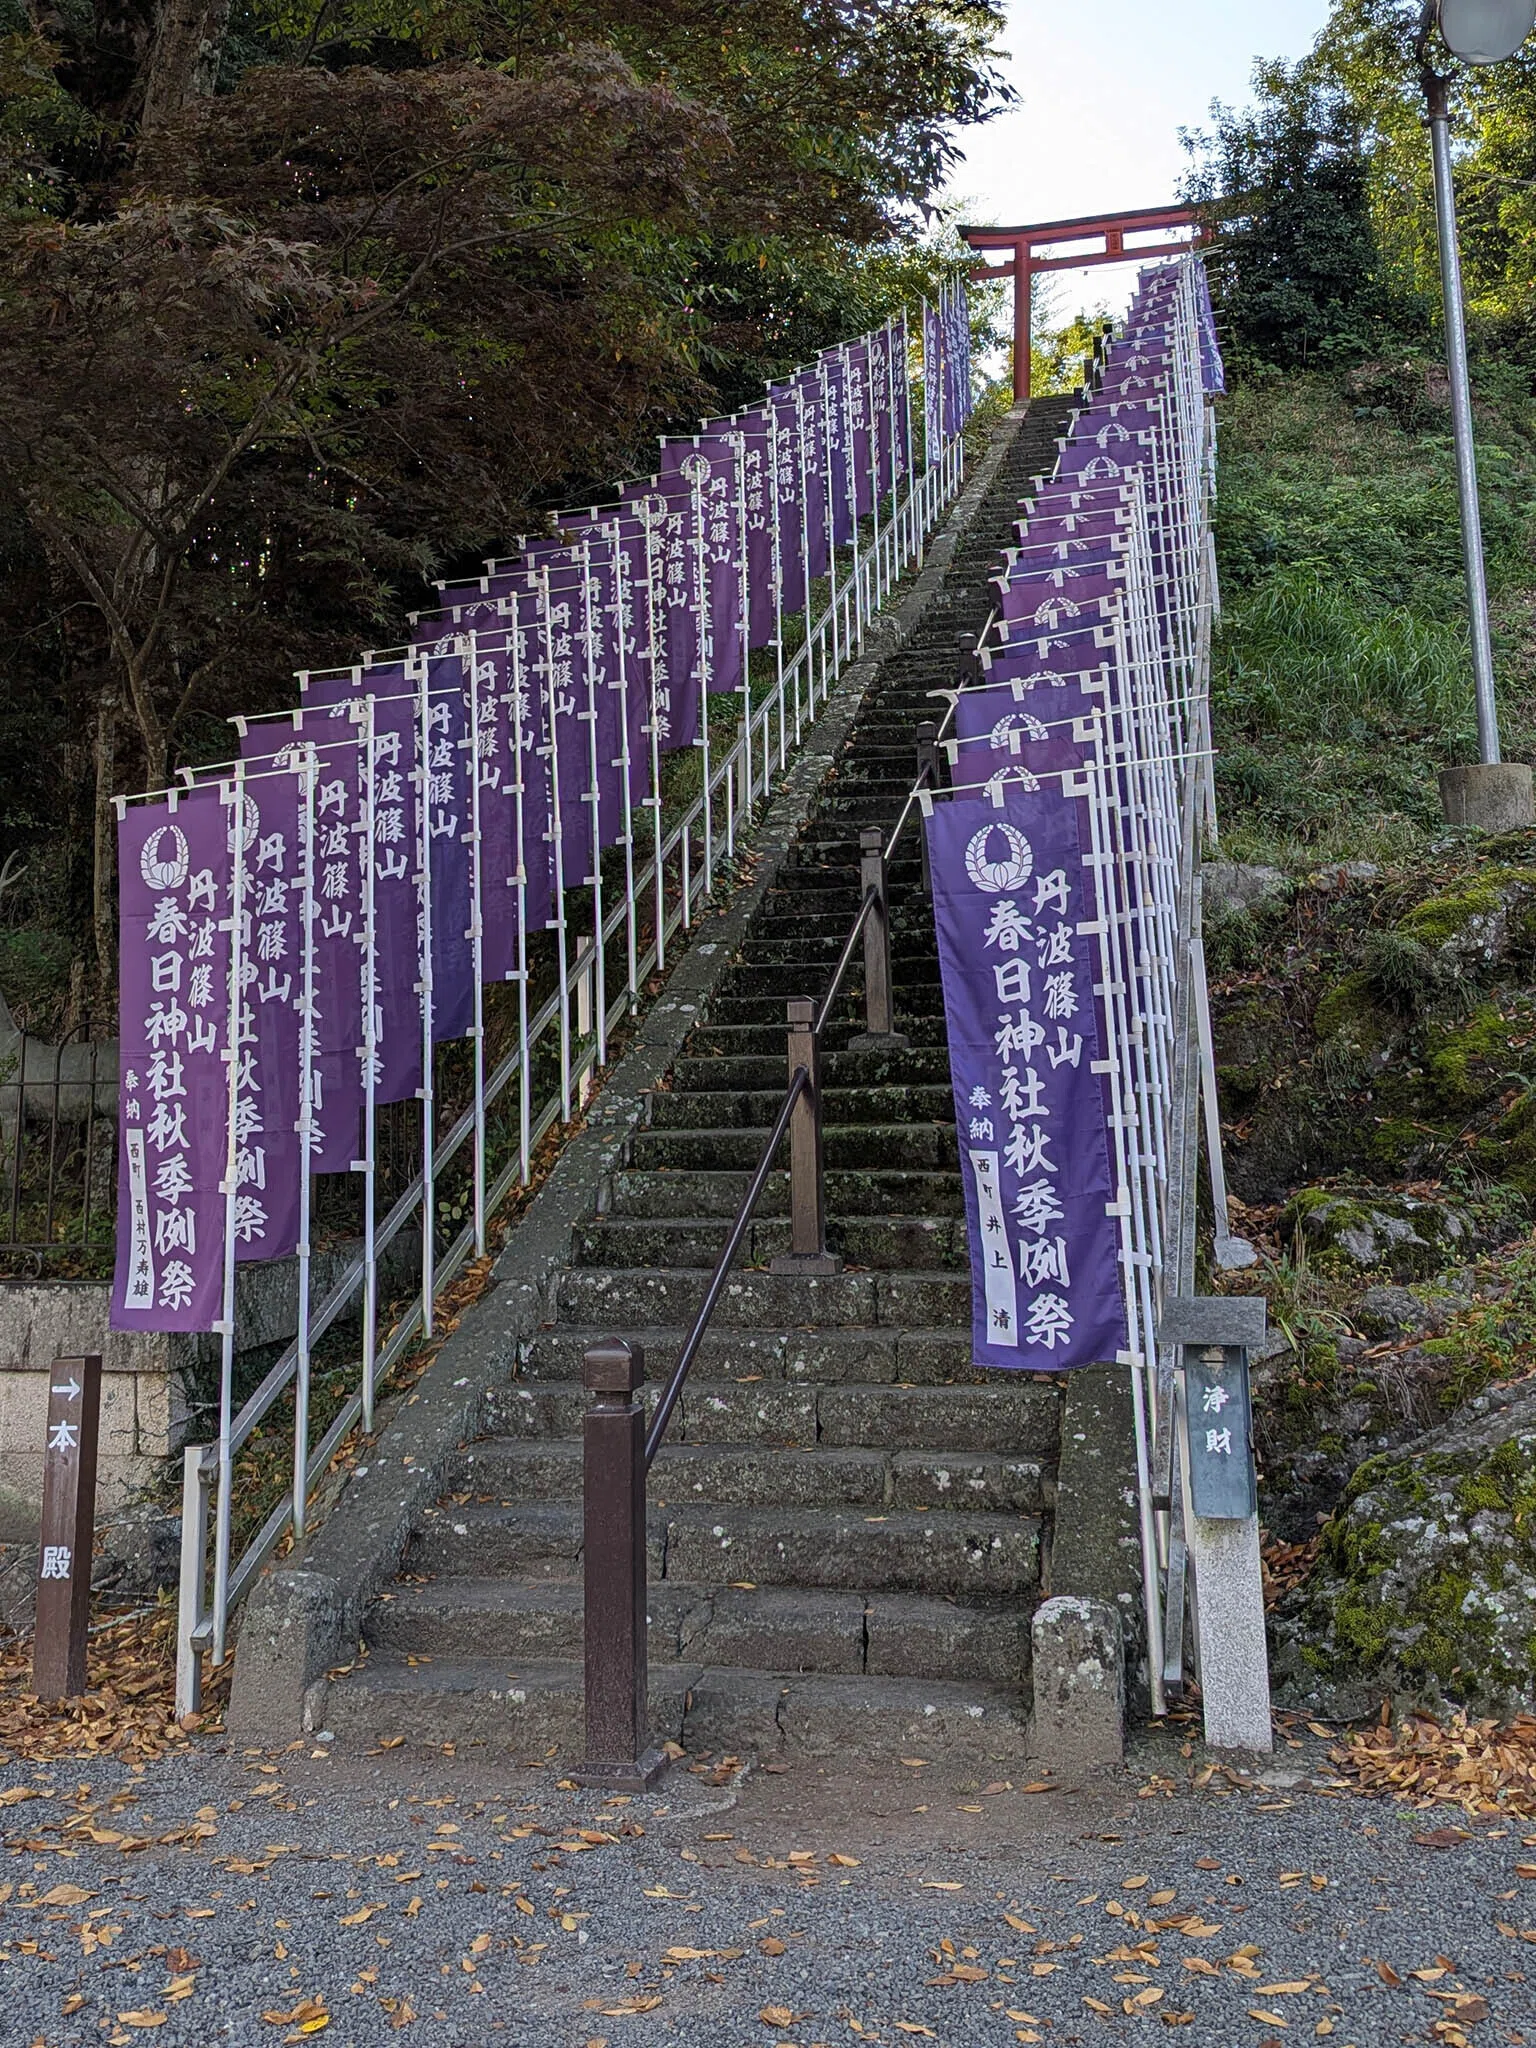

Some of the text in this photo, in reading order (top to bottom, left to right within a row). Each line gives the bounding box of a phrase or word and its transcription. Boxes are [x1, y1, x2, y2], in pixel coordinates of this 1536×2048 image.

[708, 476, 732, 565] 丹波篠山
[746, 449, 765, 531] 丹波篠山
[777, 427, 796, 504] 丹波篠山
[665, 514, 688, 609] 丹波篠山
[551, 602, 576, 717] 丹波篠山
[428, 702, 458, 839] 丹波篠山
[476, 660, 501, 790] 丹波篠山
[318, 779, 353, 939] 丹波篠山
[373, 731, 409, 881] 丹波篠山
[187, 868, 218, 1055] 丹波篠山
[255, 832, 292, 1003] 丹波篠山
[1032, 868, 1082, 1070] 丹波篠山
[125, 1069, 141, 1121] 奉納
[145, 896, 196, 1311] 春日神社秋季例祭
[969, 1085, 994, 1143] 奉納
[983, 900, 1075, 1350] 春日神社秋季例祭
[1203, 1385, 1232, 1456] 浄財
